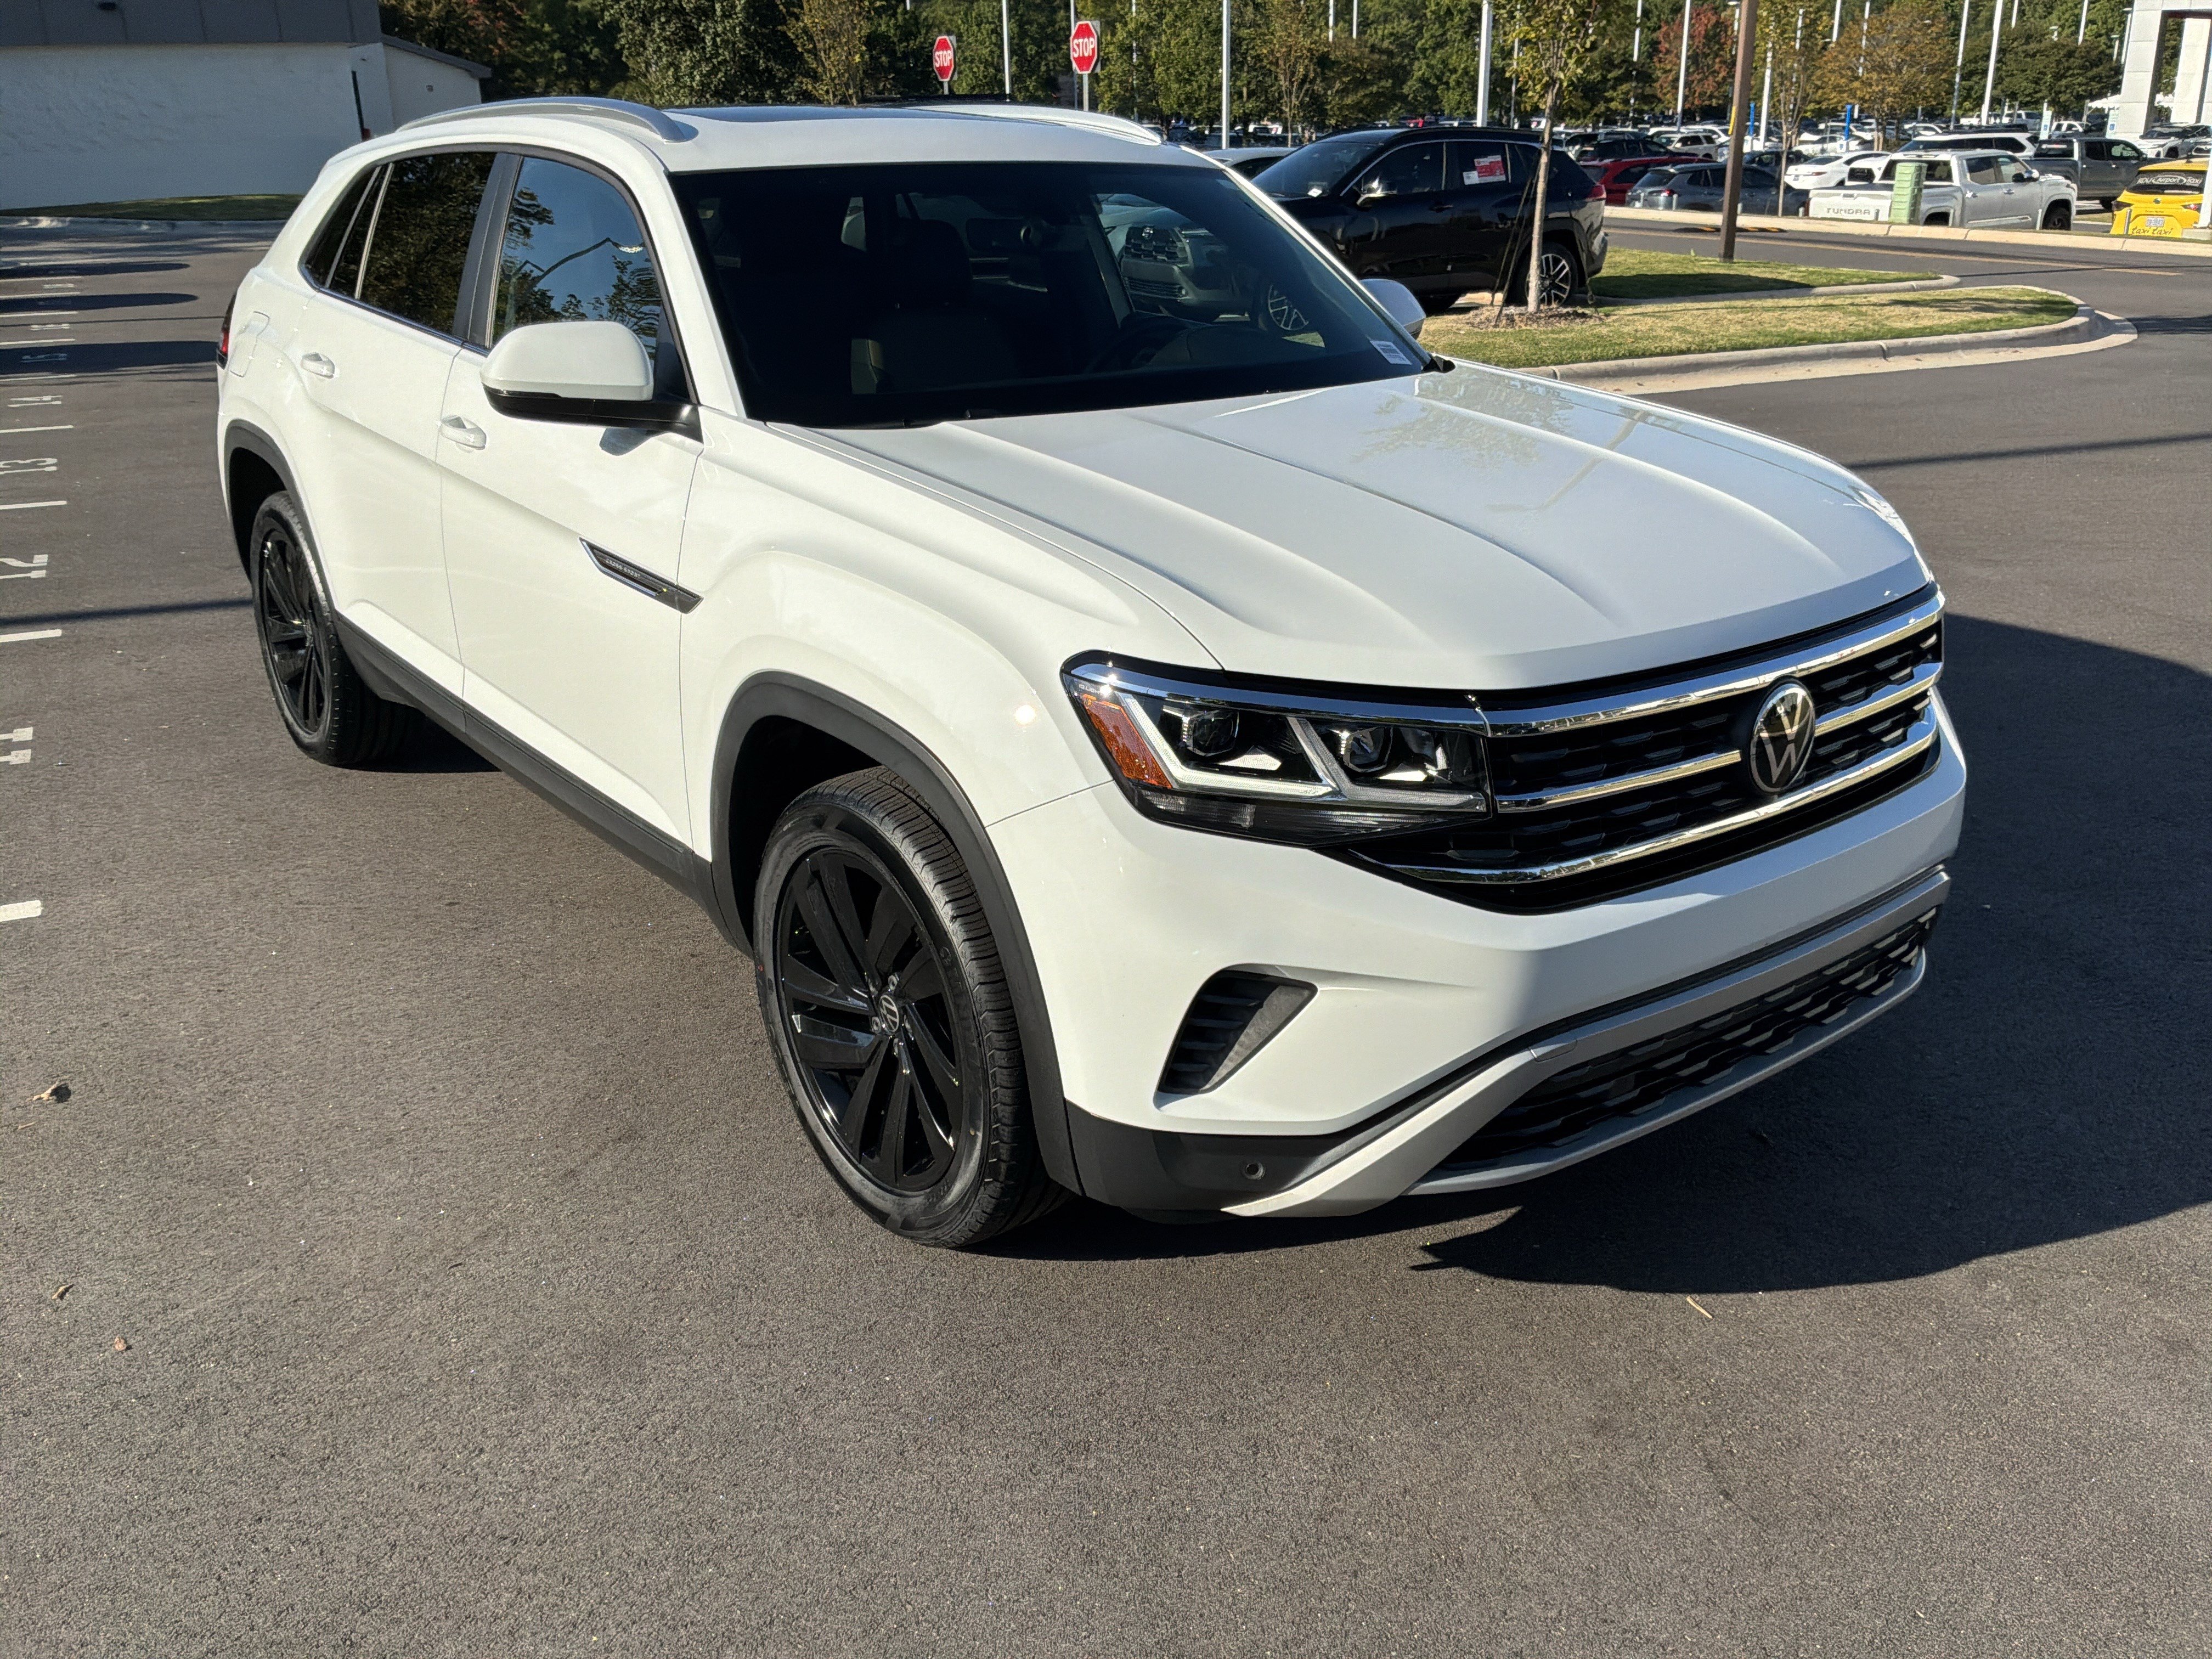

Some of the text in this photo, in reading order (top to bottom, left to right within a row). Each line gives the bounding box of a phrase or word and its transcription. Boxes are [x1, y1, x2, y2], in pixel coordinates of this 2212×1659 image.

[1073, 37, 1095, 58] STOP
[935, 50, 952, 67] STOP
[2186, 176, 2202, 184] Taxi
[2132, 225, 2174, 235] taxi taxi
[1751, 684, 1814, 792] VW
